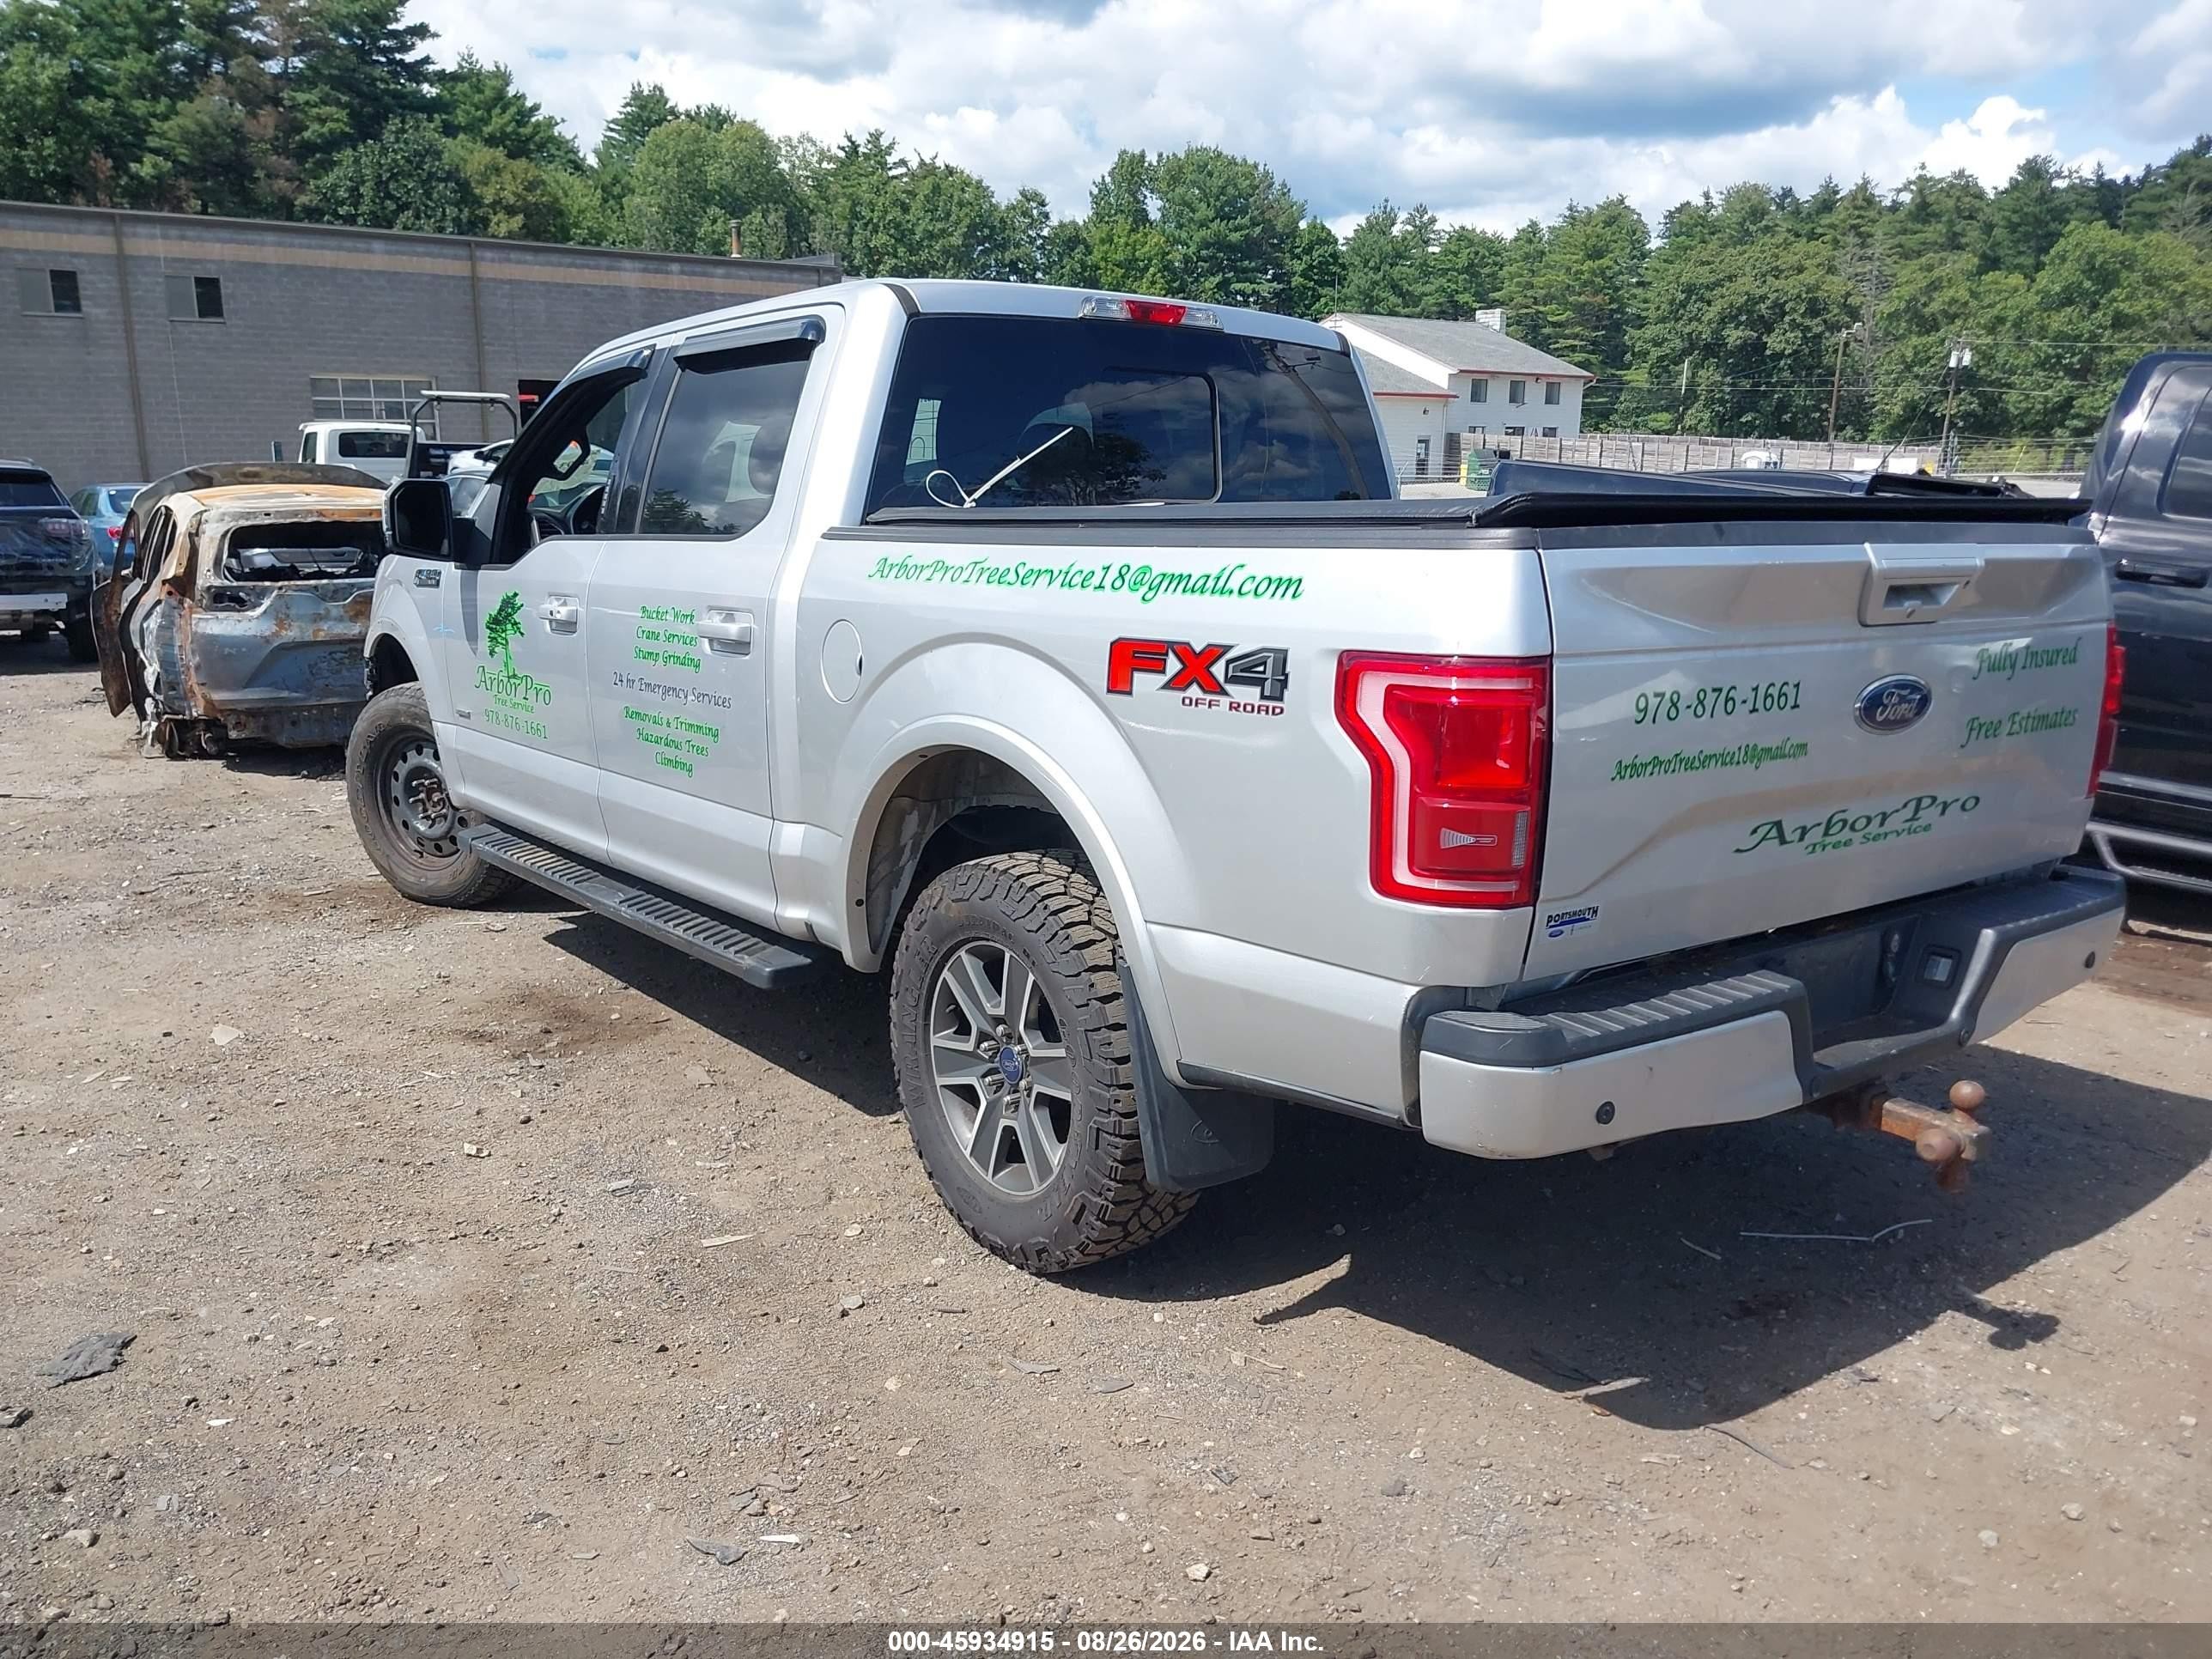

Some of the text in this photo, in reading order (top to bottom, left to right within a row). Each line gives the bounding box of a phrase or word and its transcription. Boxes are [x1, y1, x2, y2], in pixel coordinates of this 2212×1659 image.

[868, 554, 1304, 603] ArborProTreeService18@gmail.com
[640, 605, 696, 625] Bucket Work
[635, 625, 698, 647] Crane Services
[634, 646, 702, 673] Stump Grinding
[1105, 635, 1289, 702] FX4
[1972, 637, 2083, 680] Fully Insured
[494, 694, 535, 714] Tree Service
[612, 672, 732, 709] 24 hr Emergency Services
[1181, 695, 1285, 716] OFF ROAD
[1632, 681, 1802, 725] 978-876-1661
[1876, 689, 1922, 722] Ford
[484, 708, 549, 740] 978-876-1661
[623, 706, 720, 743] Removals & Trimming
[1960, 707, 2079, 749] Free Estimates
[636, 727, 710, 757] Hazardous Trees
[654, 751, 694, 777] Climbing
[1610, 738, 1808, 782] ArborProTreeService18@gmail.com
[1804, 820, 1932, 855] Tree Service
[1546, 905, 1600, 927] PORTSMOUTH
